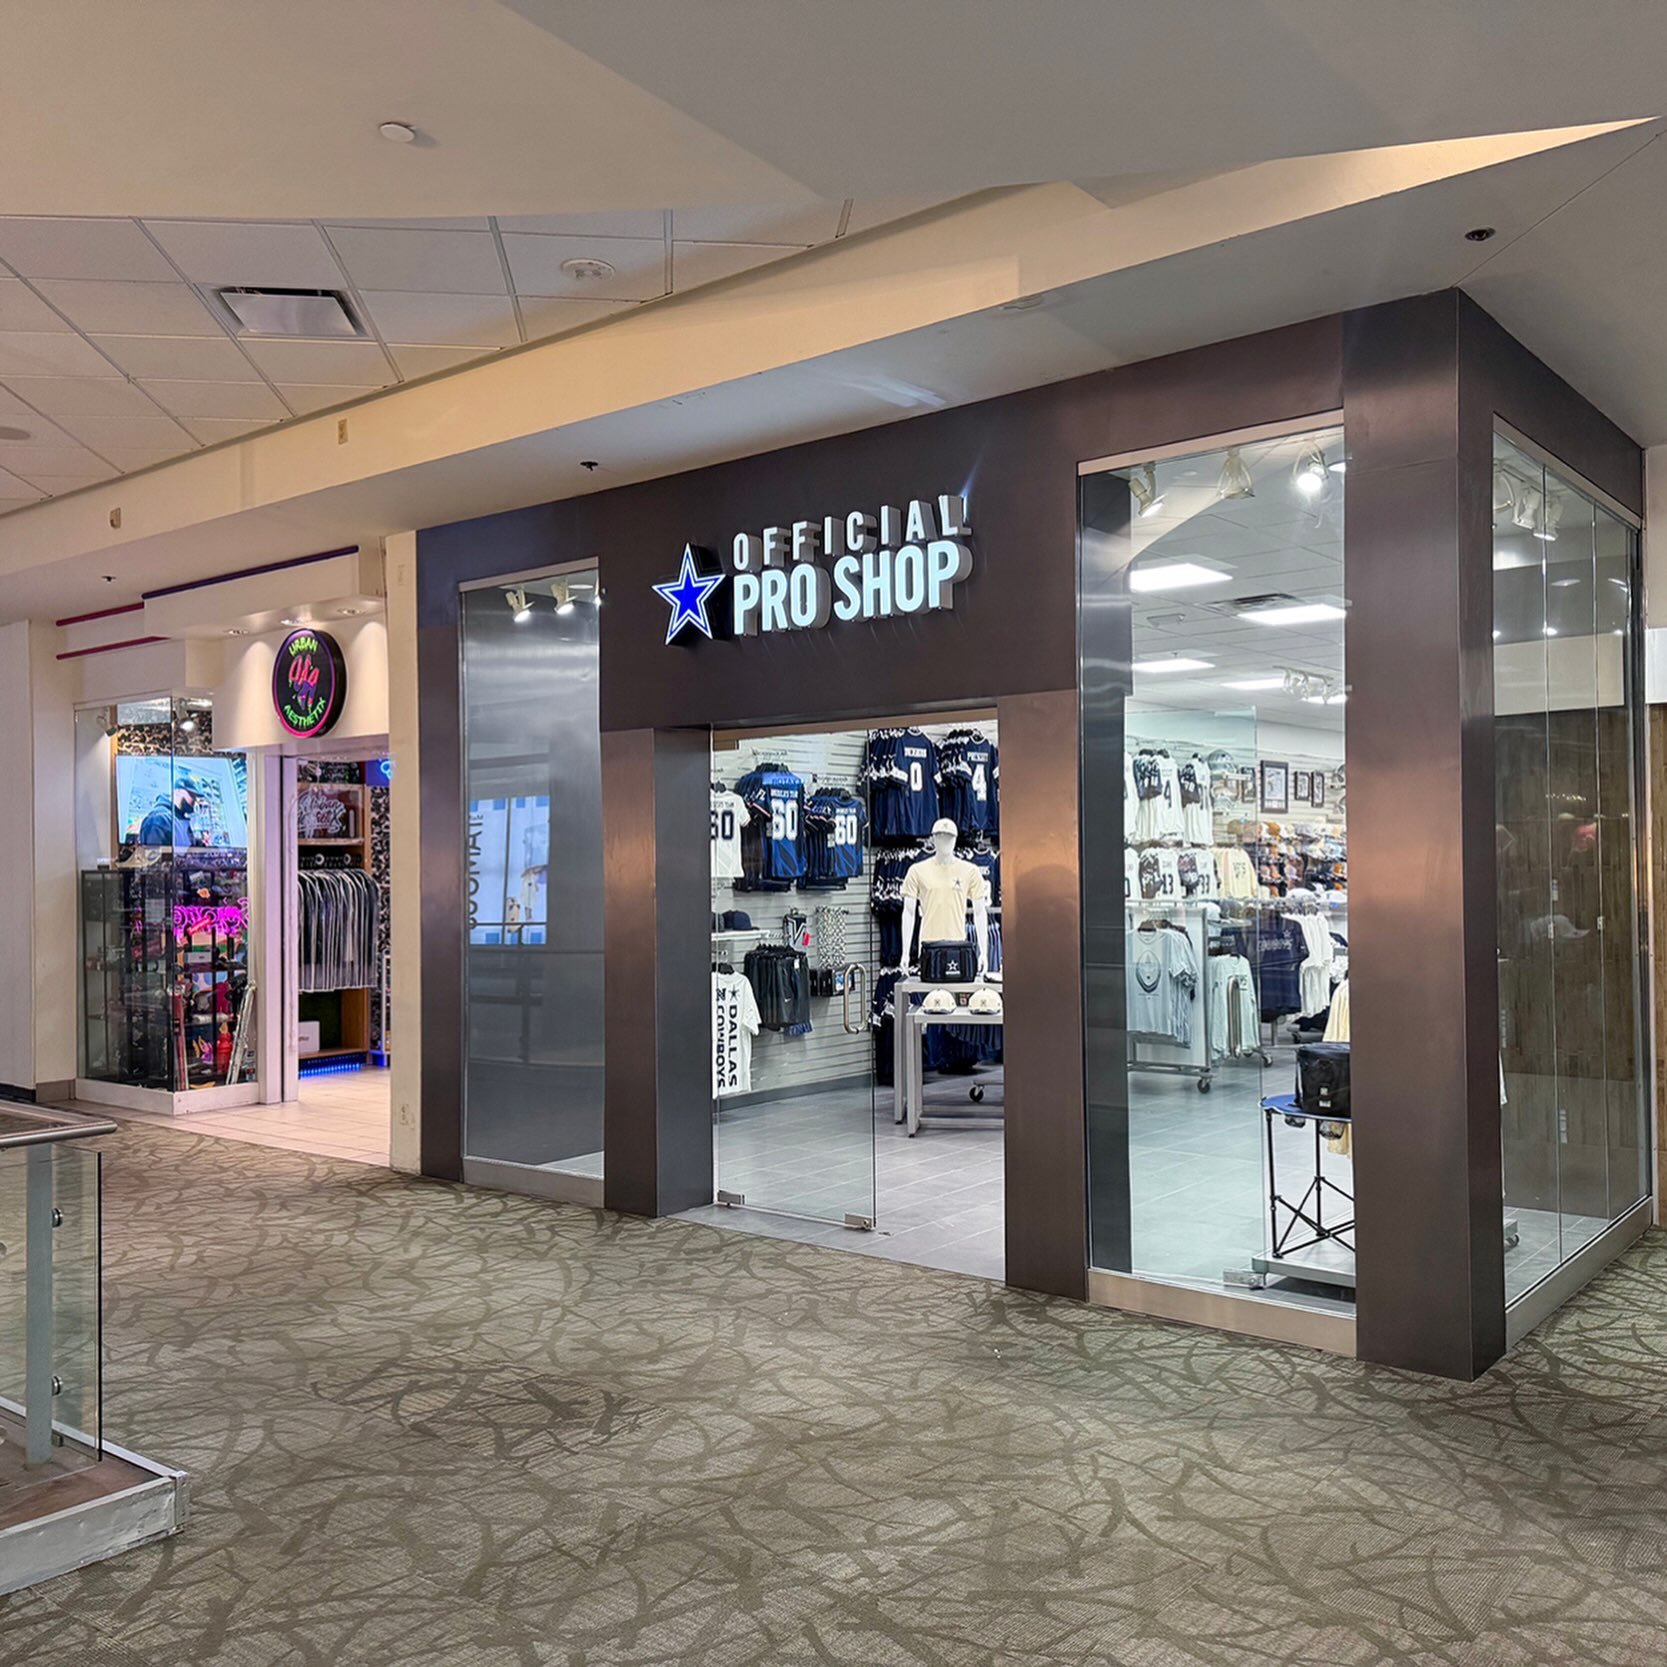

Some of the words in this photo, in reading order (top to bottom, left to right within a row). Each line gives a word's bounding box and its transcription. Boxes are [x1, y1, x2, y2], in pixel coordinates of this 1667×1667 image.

[733, 494, 969, 570] OFFICIAL
[733, 563, 818, 636] PRO
[834, 541, 961, 622] SHOP
[288, 636, 319, 656] URBAN
[909, 761, 923, 792] 0
[972, 764, 988, 801] 4
[770, 798, 799, 841] 60
[834, 814, 858, 846] 60
[728, 1005, 738, 1087] DALLAS
